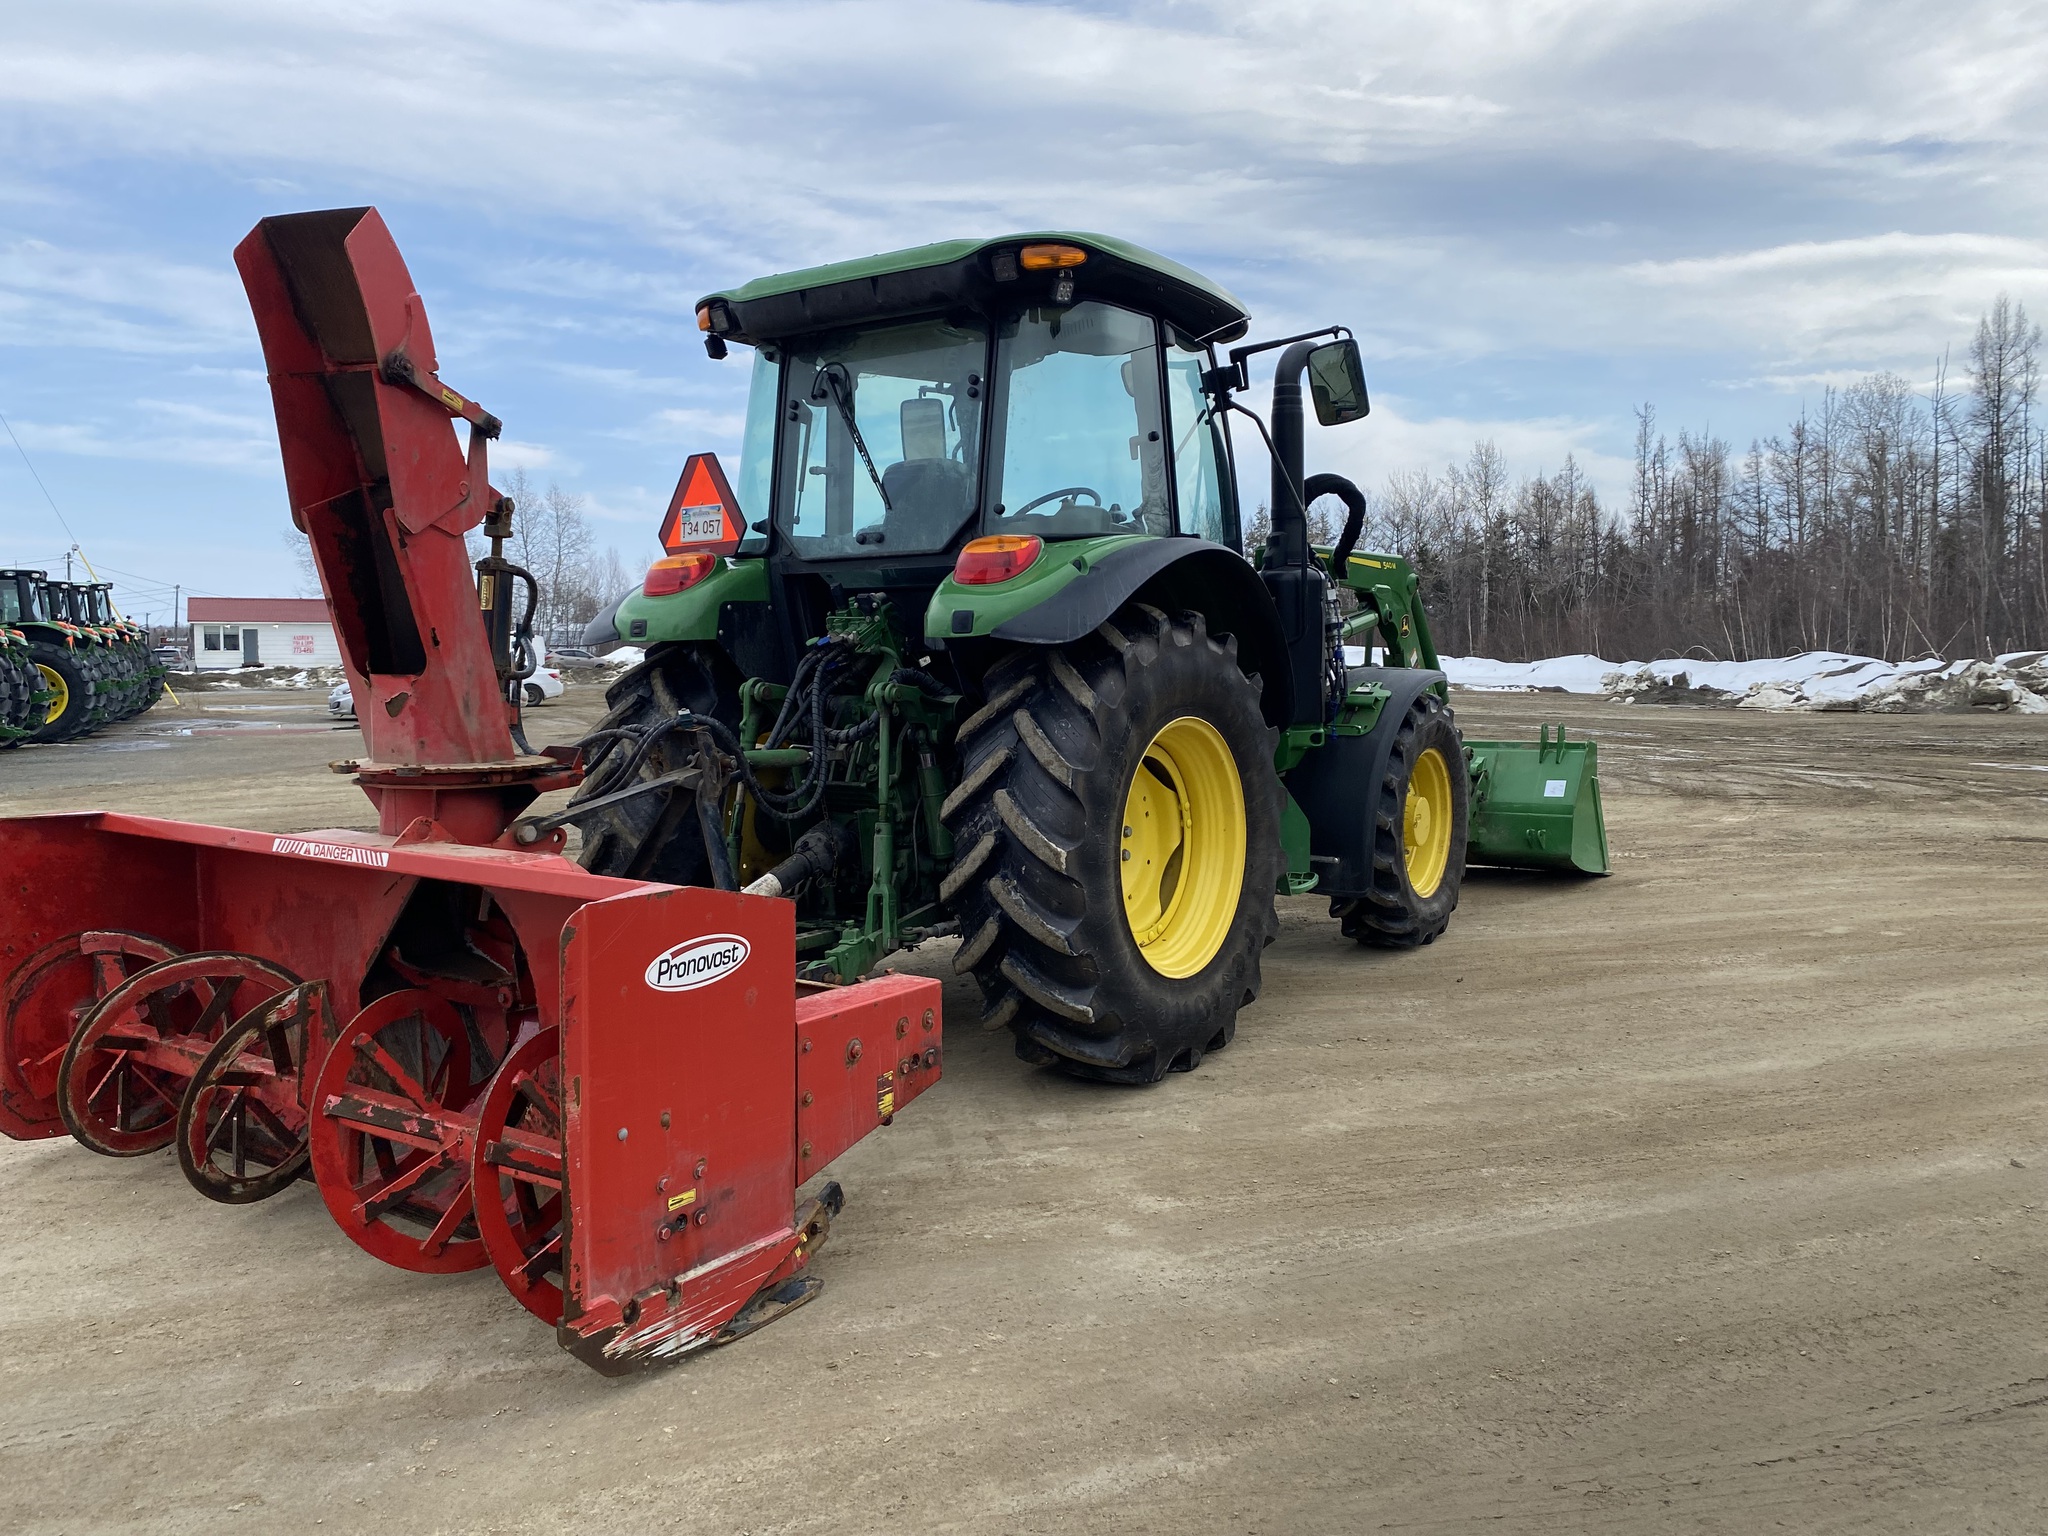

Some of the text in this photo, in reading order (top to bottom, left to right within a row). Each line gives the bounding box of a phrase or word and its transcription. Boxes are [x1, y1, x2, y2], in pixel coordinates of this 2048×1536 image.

[682, 519, 720, 536] T34 057
[1383, 561, 1396, 569] 540M
[314, 844, 354, 861] DANGER
[657, 944, 739, 984] Pronovost
